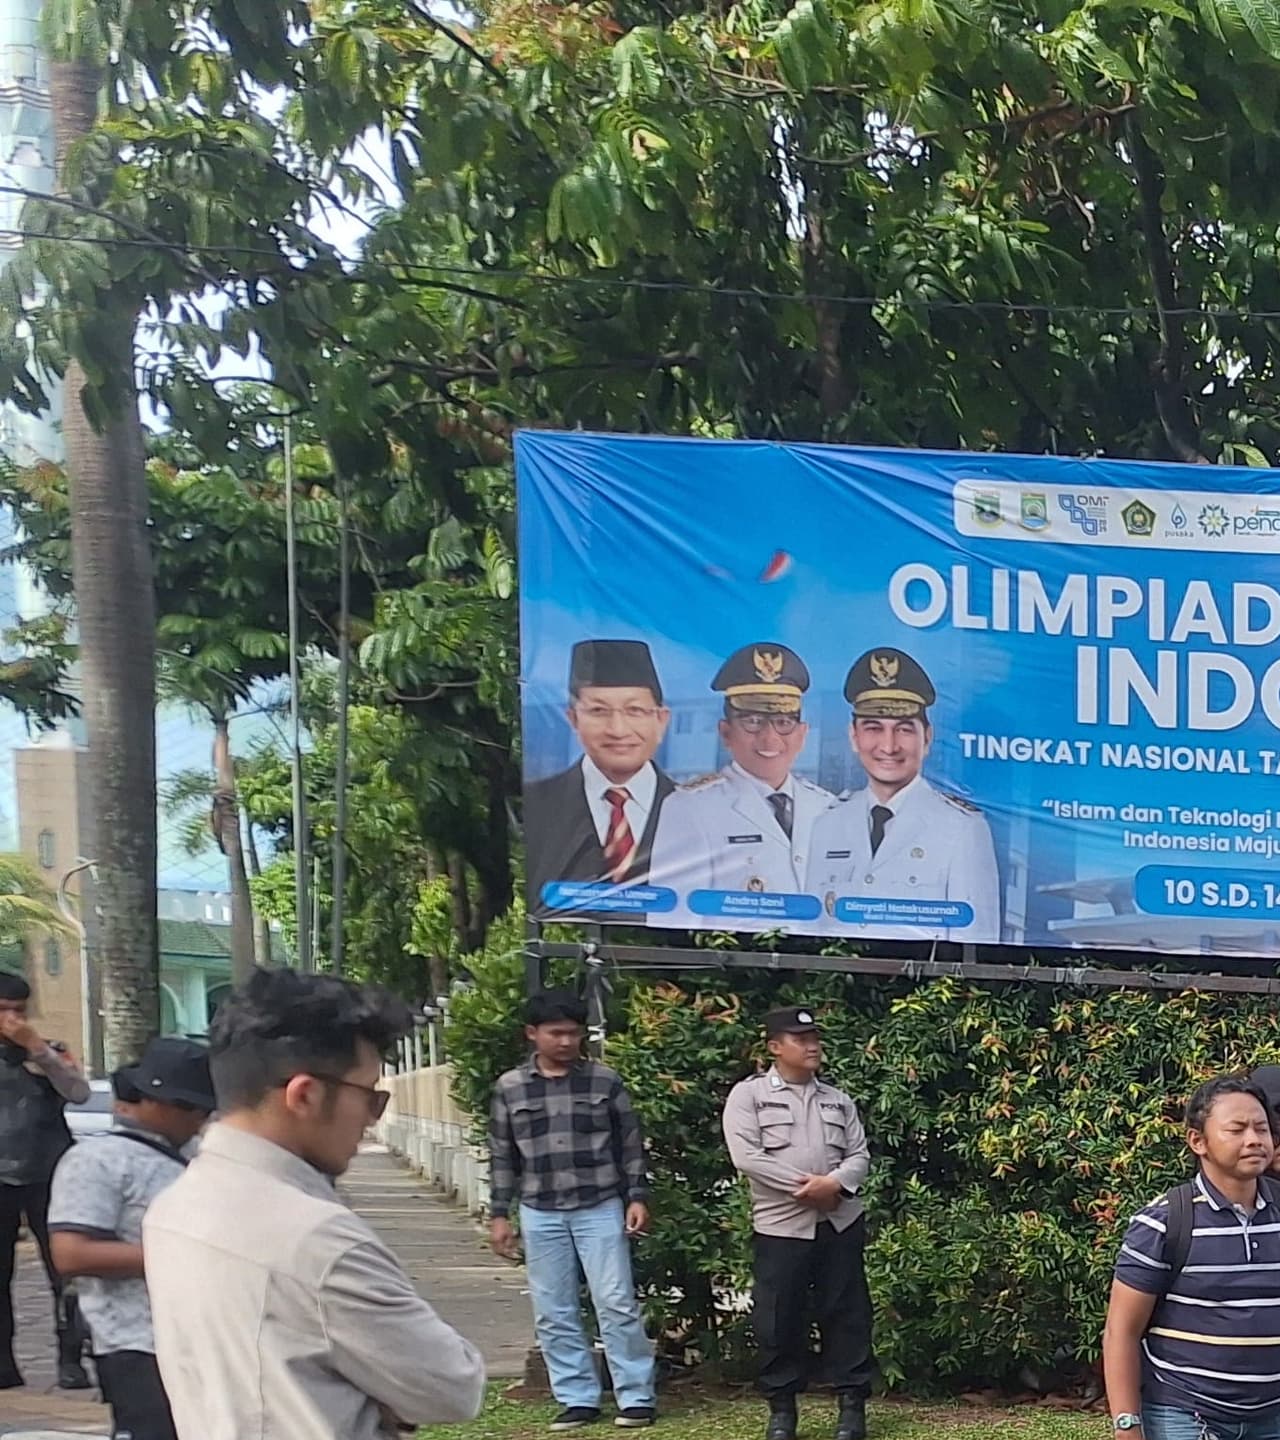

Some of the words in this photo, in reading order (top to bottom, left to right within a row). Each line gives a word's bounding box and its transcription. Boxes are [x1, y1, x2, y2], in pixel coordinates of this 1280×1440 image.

[959, 733, 1092, 767] TINGKAT
[1101, 745, 1250, 774] NASIONAL
[1120, 803, 1163, 823] dan
[1168, 806, 1271, 833] Teknologi
[1123, 830, 1230, 853] Indonesia
[1164, 879, 1194, 905] 10
[1202, 881, 1257, 908] S.D.
